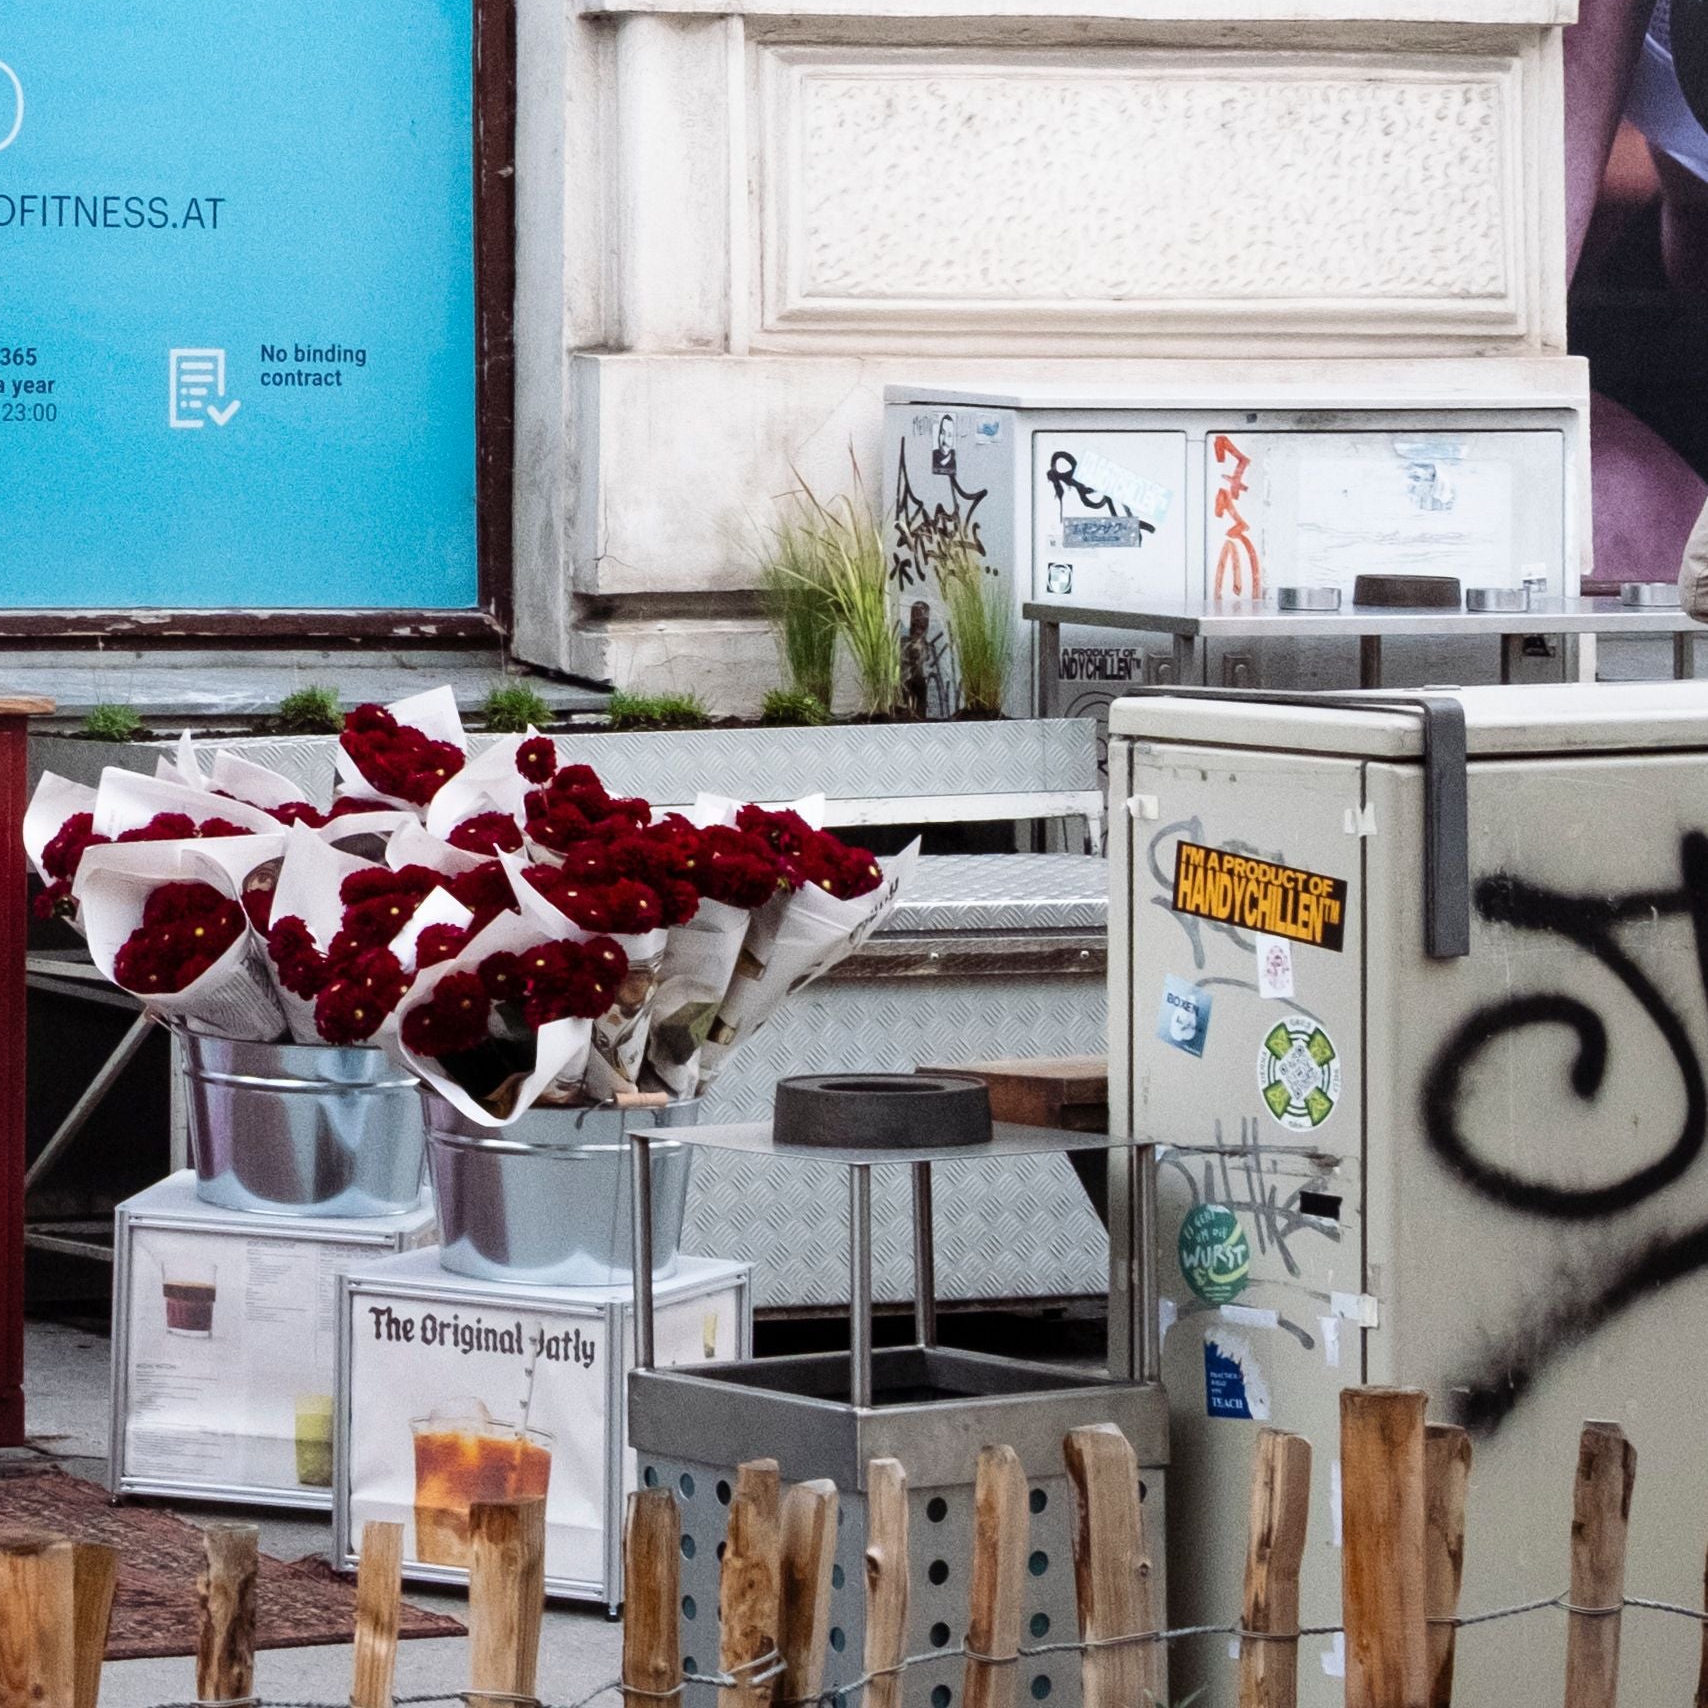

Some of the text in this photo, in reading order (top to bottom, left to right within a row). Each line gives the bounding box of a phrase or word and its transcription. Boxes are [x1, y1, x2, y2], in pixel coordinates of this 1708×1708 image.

[0, 347, 38, 367] 365
[260, 344, 367, 366] No binding
[12, 378, 55, 399] year
[260, 369, 342, 387] contract
[1, 403, 58, 422] 23:00
[1062, 648, 1137, 658] A PRODUCT OF
[1181, 844, 1333, 896] I'M A PRODUCT OF
[1166, 993, 1200, 1016] BOXEN
[1183, 1244, 1246, 1270] WURST
[368, 1305, 414, 1342] The
[420, 1311, 522, 1356] Original
[1211, 1396, 1243, 1409] TEACH
